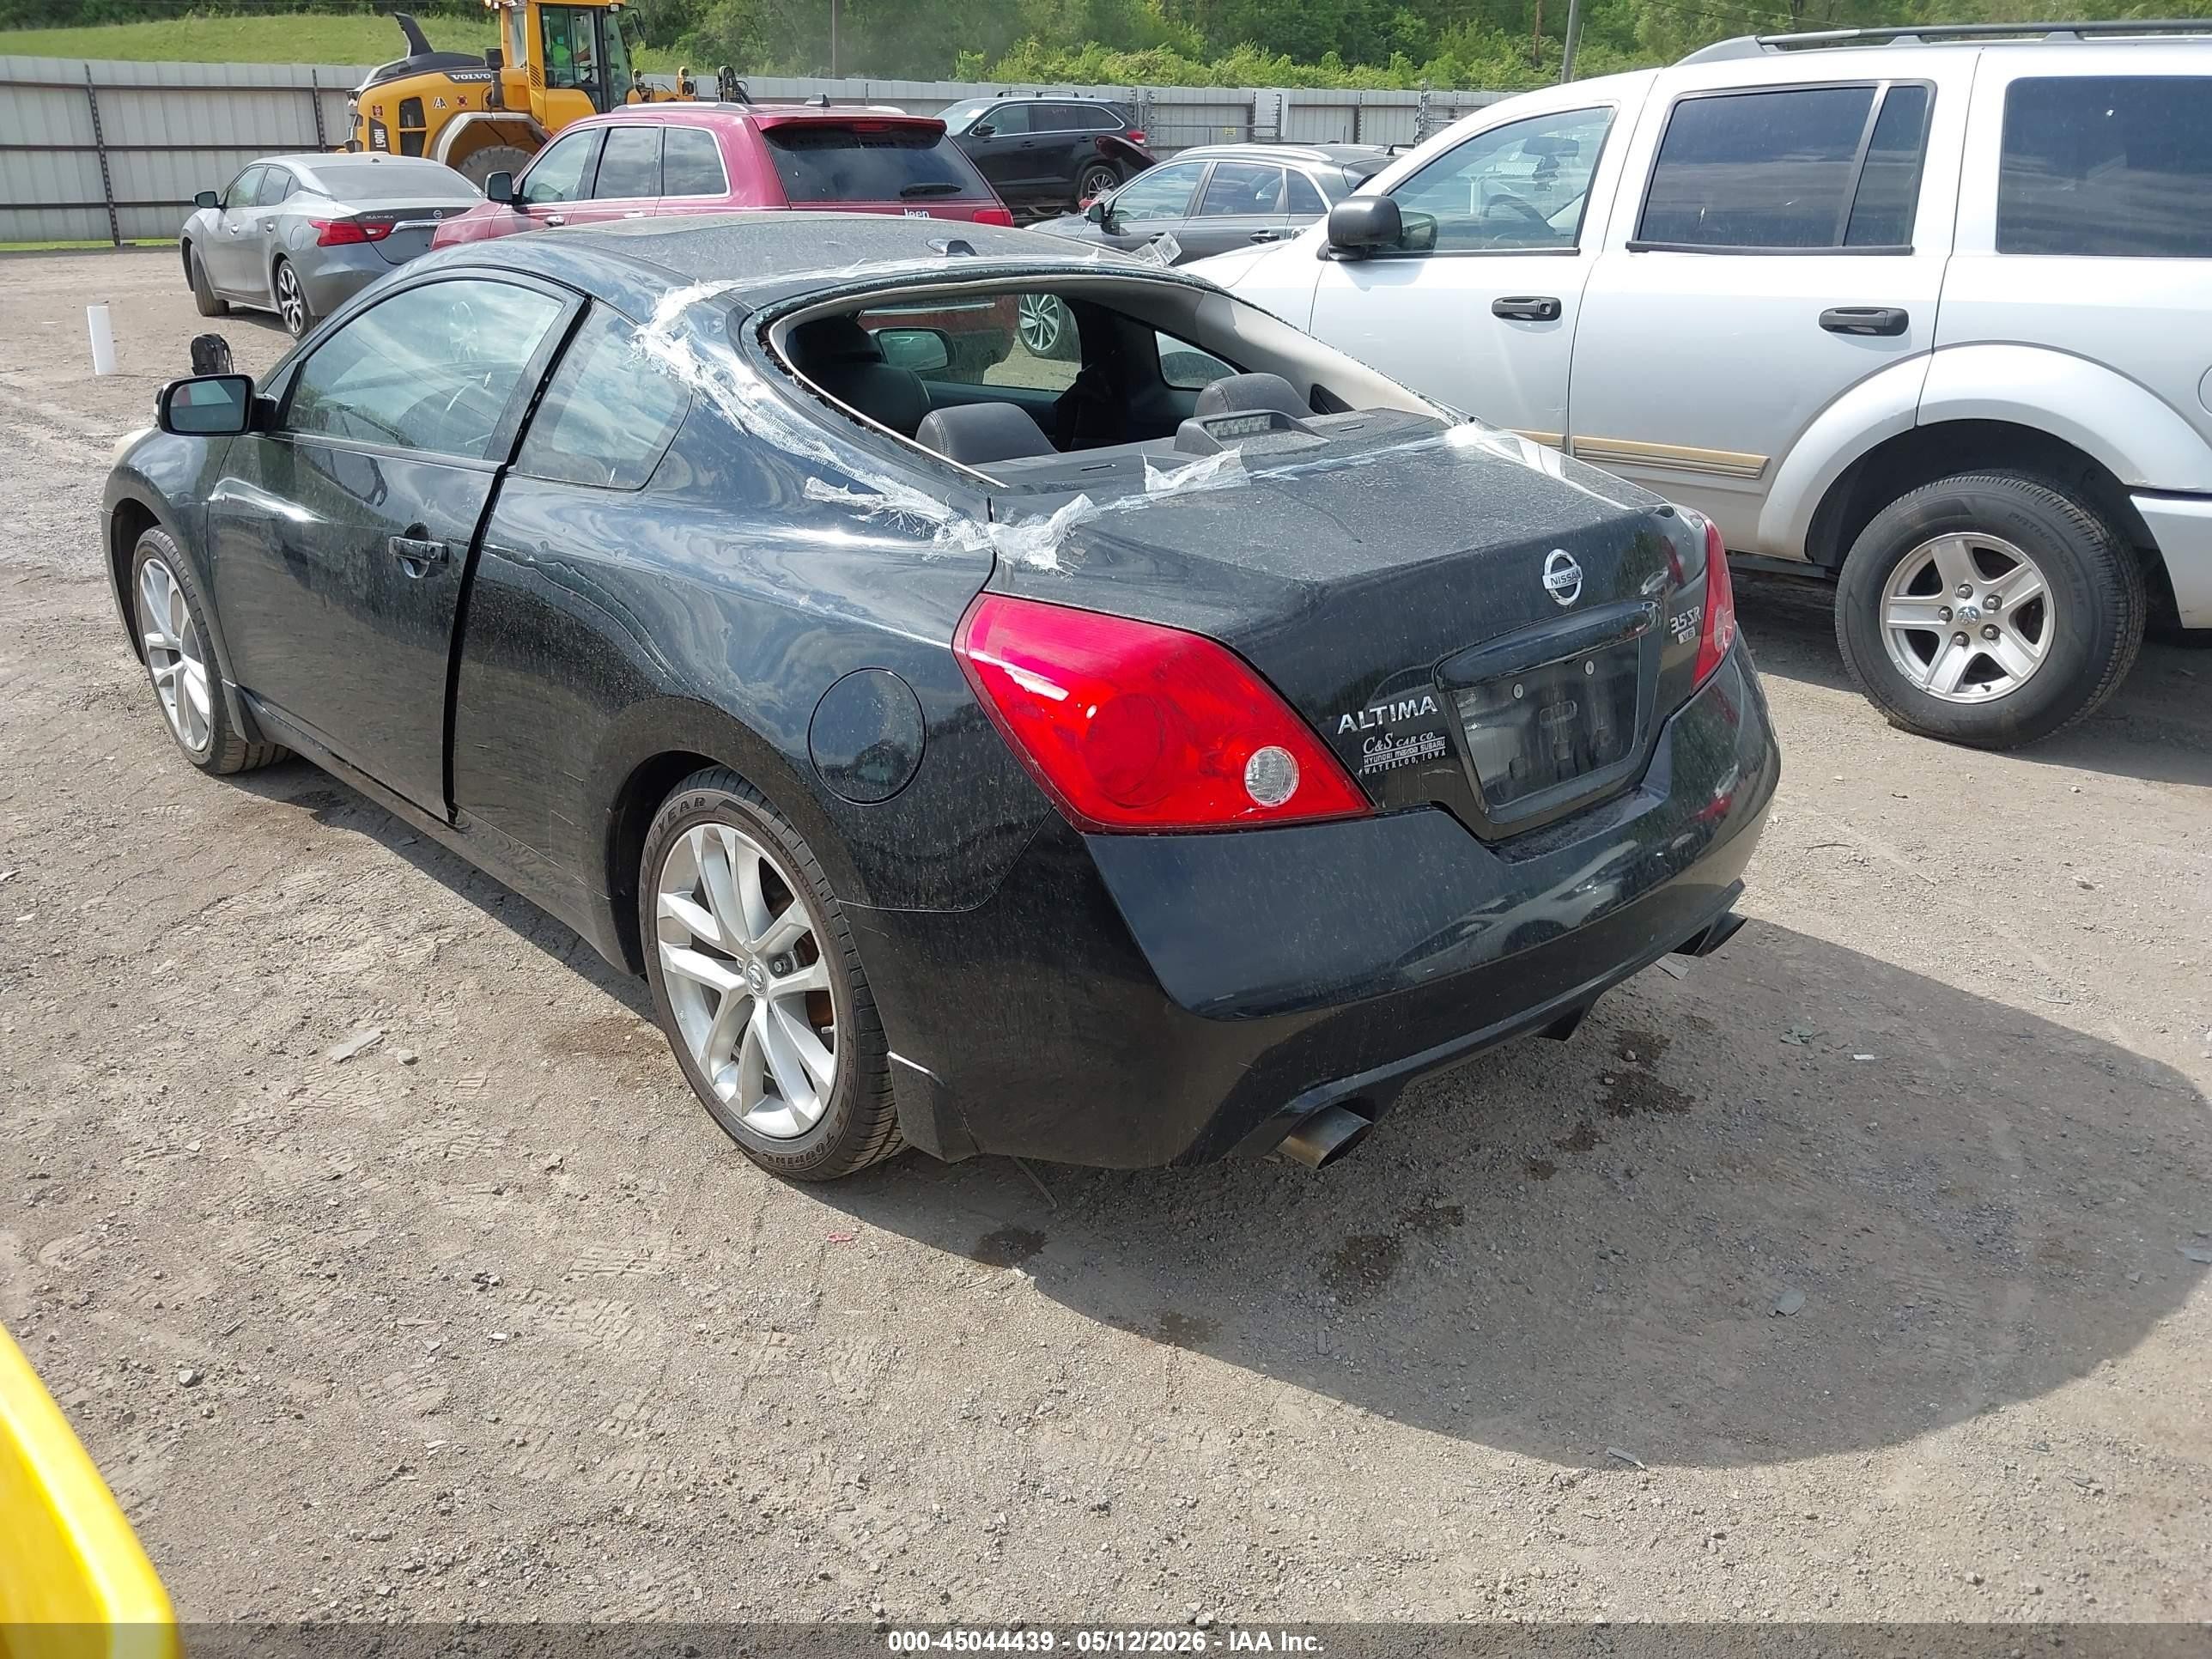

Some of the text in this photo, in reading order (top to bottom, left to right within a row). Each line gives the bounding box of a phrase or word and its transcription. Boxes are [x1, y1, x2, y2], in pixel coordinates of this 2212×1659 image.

[374, 129, 386, 148] L90H
[1550, 569, 1582, 586] NISSAN
[1337, 696, 1438, 735] ALTIMA
[1363, 732, 1436, 754] C&S CAR CO.
[1364, 753, 1393, 765] HYUNDAI
[1419, 738, 1446, 751] SUBARU
[1364, 750, 1446, 775] WATERLOO, IOWA
